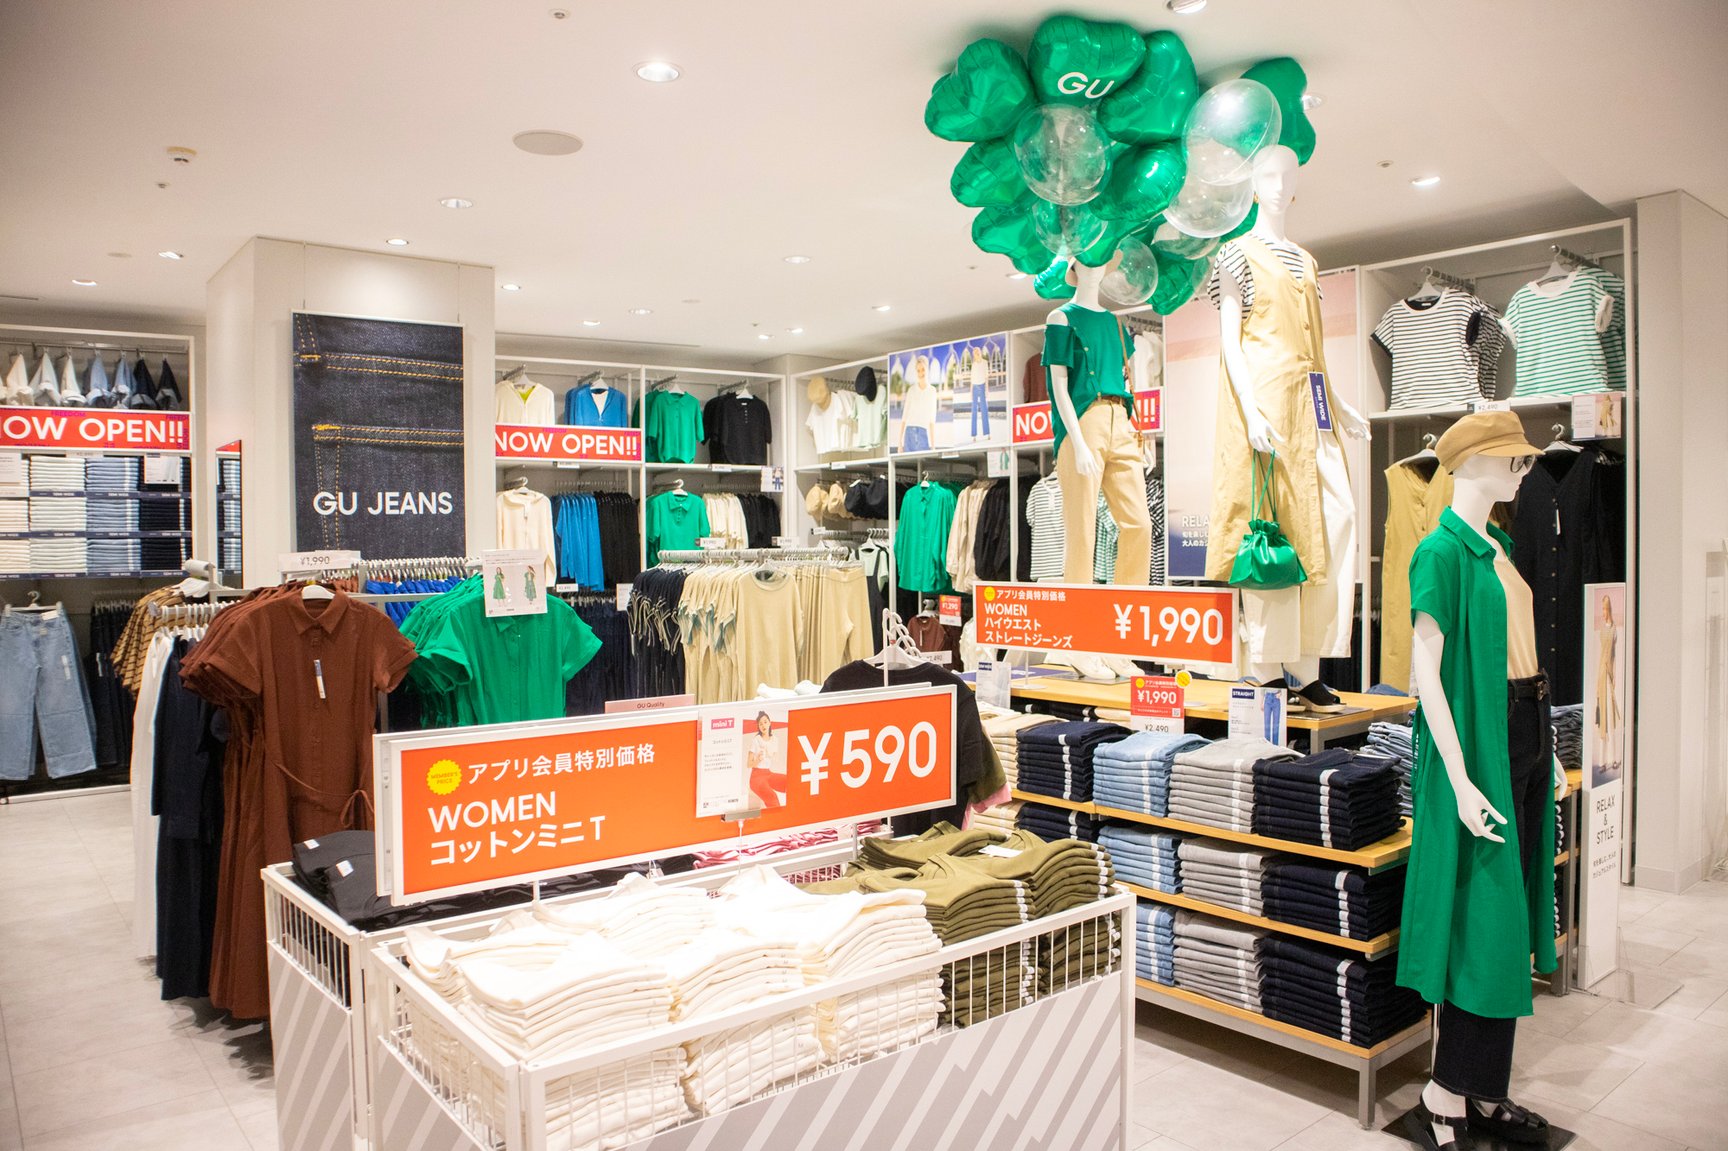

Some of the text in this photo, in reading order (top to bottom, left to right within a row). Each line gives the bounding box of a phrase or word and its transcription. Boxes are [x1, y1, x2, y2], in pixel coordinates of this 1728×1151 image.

[1057, 71, 1115, 99] GU
[0, 415, 68, 441] OW
[79, 417, 183, 444] OPEN!!
[1015, 408, 1051, 437] NO
[561, 433, 637, 456] OPEN!!
[312, 491, 454, 516] GU JEANS
[299, 555, 330, 567] ¥1,990
[996, 589, 1066, 602] アプリ会員特別価格
[984, 602, 1028, 617] WOMEN
[984, 617, 1042, 632] ハイウエスト
[1113, 603, 1224, 647] ¥1,990
[985, 630, 1073, 649] ストレートジーンズ
[1137, 689, 1177, 705] ¥1,990
[467, 743, 656, 785] アプリ会員特別価格
[797, 720, 938, 796] ¥590
[427, 790, 556, 834] WOMEN
[1596, 794, 1616, 813] RELAX
[1596, 825, 1614, 845] STYLE
